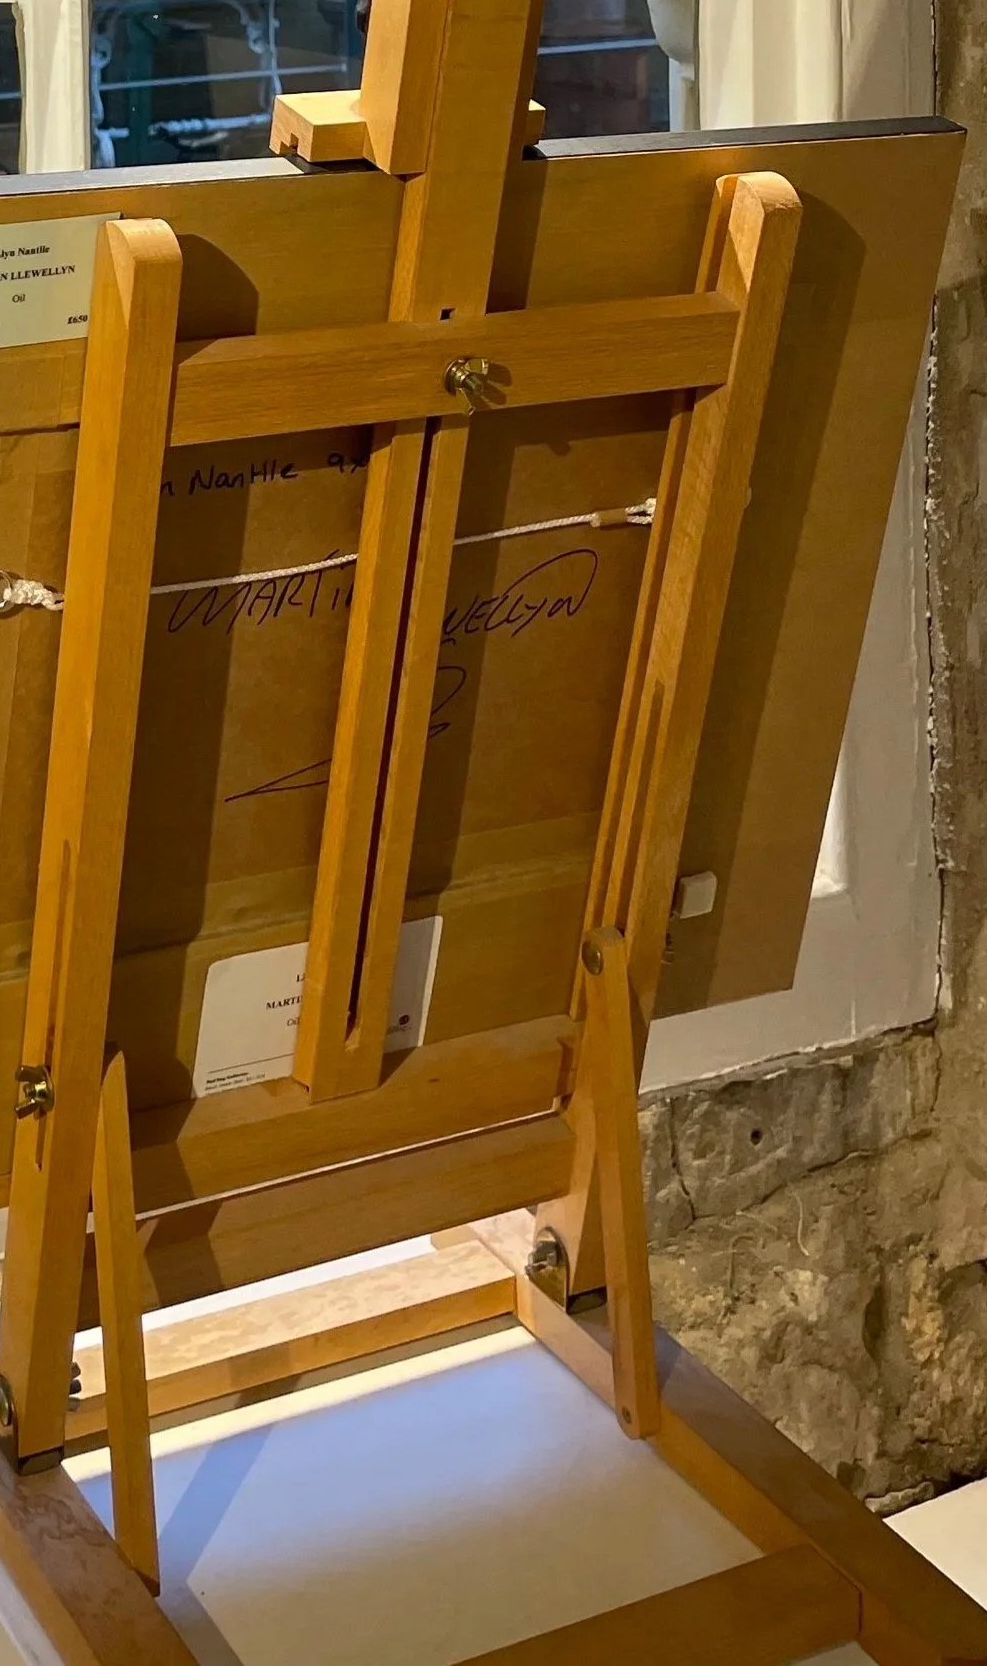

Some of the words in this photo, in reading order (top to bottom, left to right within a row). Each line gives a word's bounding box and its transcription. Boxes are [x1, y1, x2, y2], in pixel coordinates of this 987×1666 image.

[10, 265, 76, 281] LLEWELLYN
[12, 293, 26, 303] Oil
[67, 314, 89, 325] £650
[266, 995, 303, 1010] MARTI
